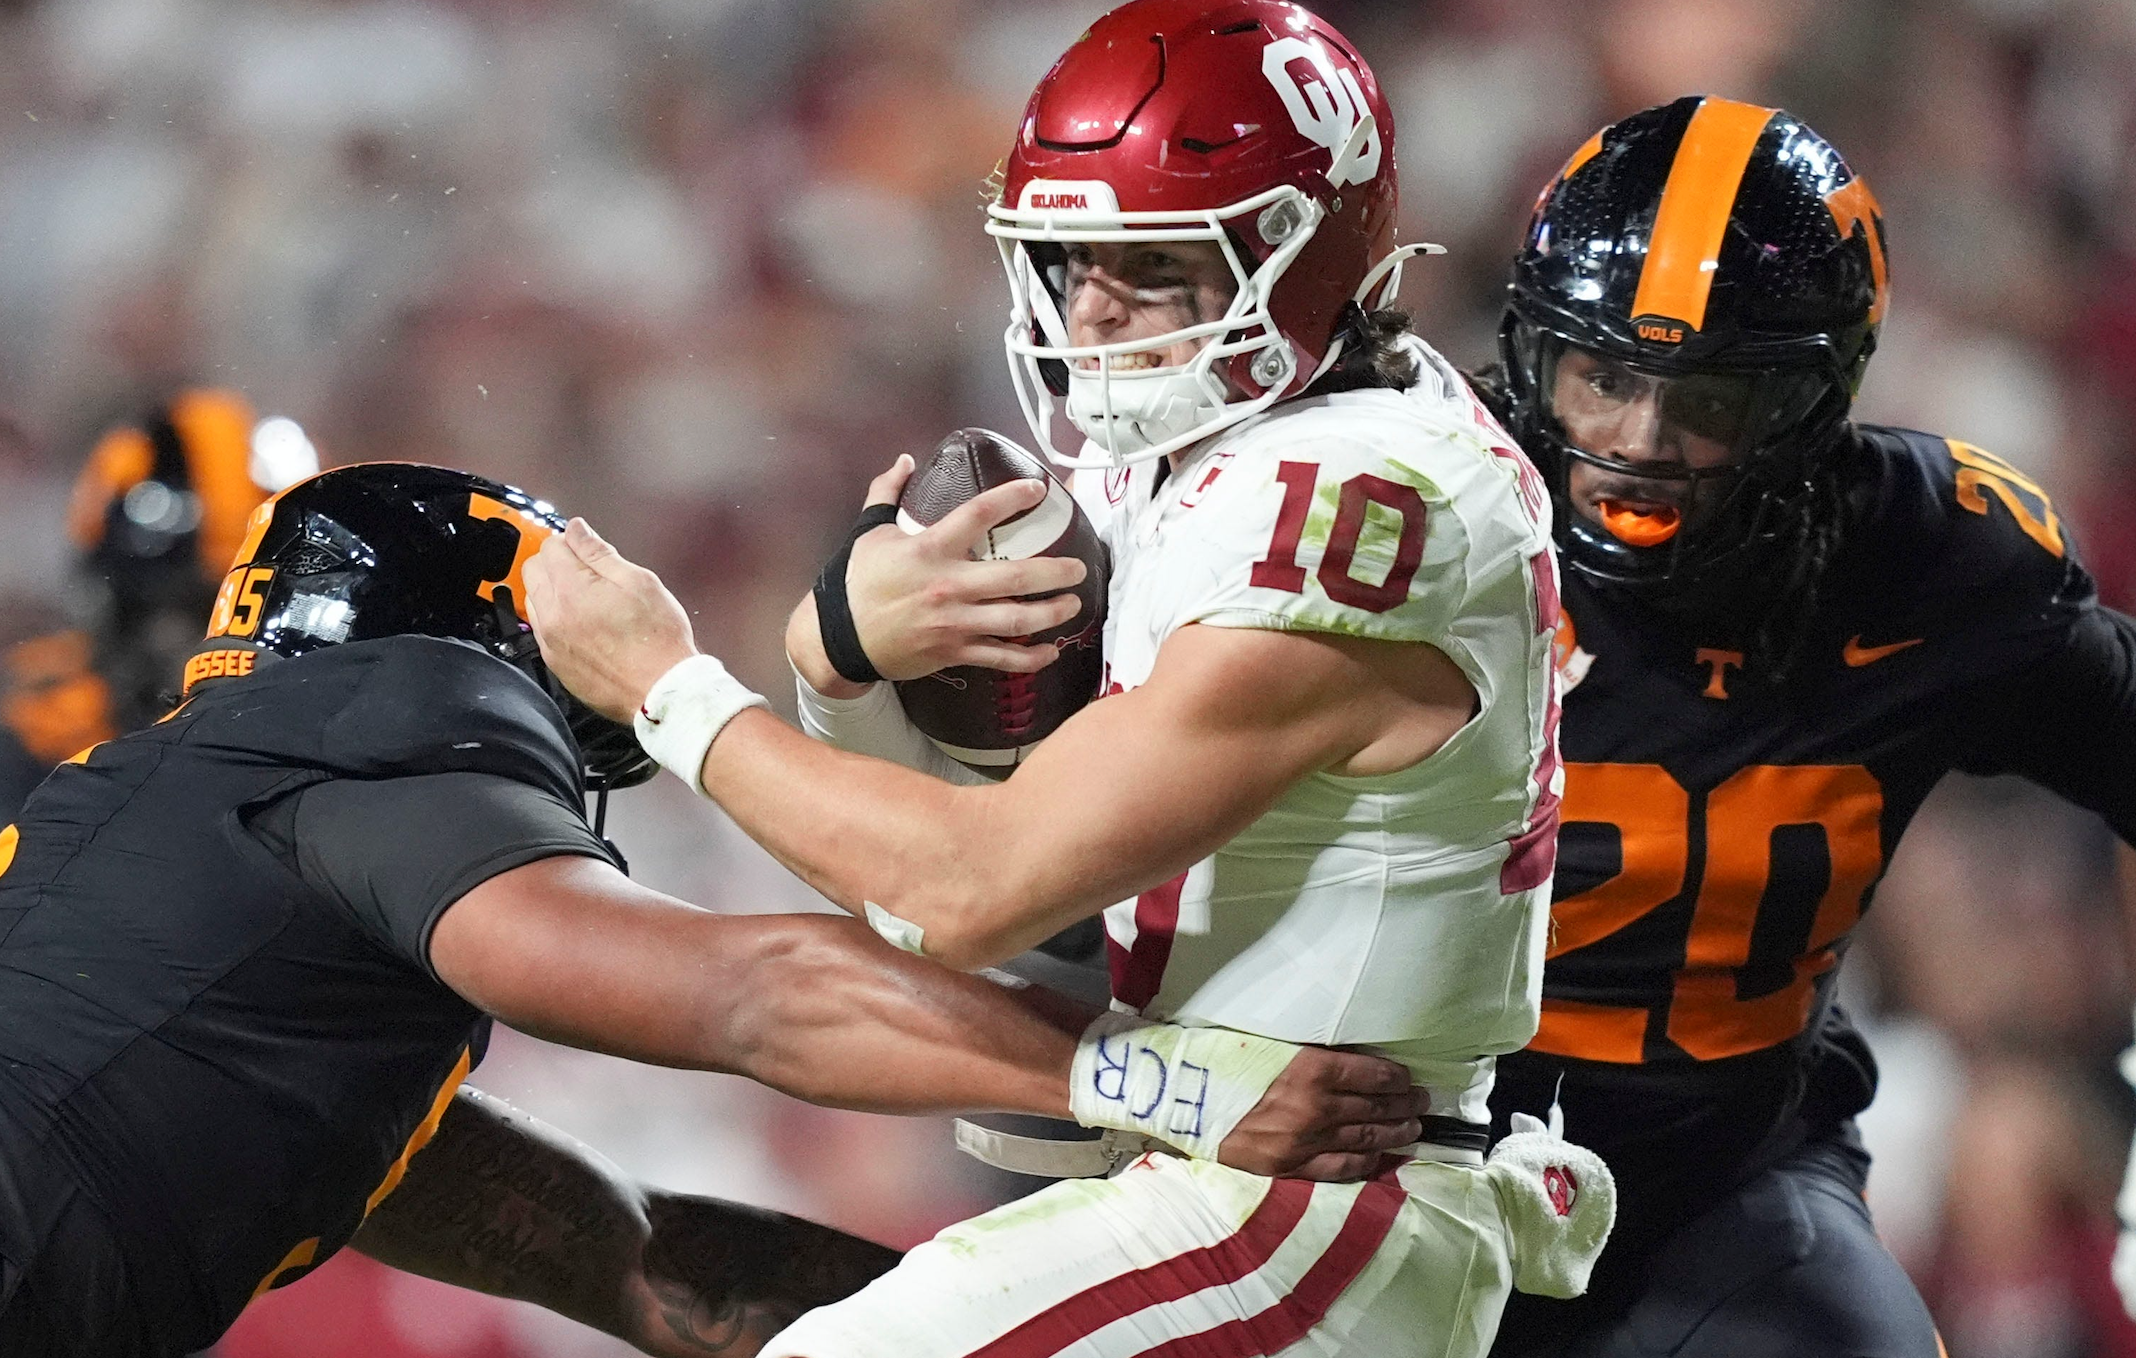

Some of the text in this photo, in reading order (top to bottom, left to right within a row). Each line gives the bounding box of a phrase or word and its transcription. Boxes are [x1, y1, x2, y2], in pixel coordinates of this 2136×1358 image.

[1031, 193, 1088, 210] OKLAHOMA
[1637, 324, 1684, 344] VOLS
[1249, 460, 1426, 614] 10
[1695, 647, 1744, 700] T
[1524, 761, 1884, 1064] 20
